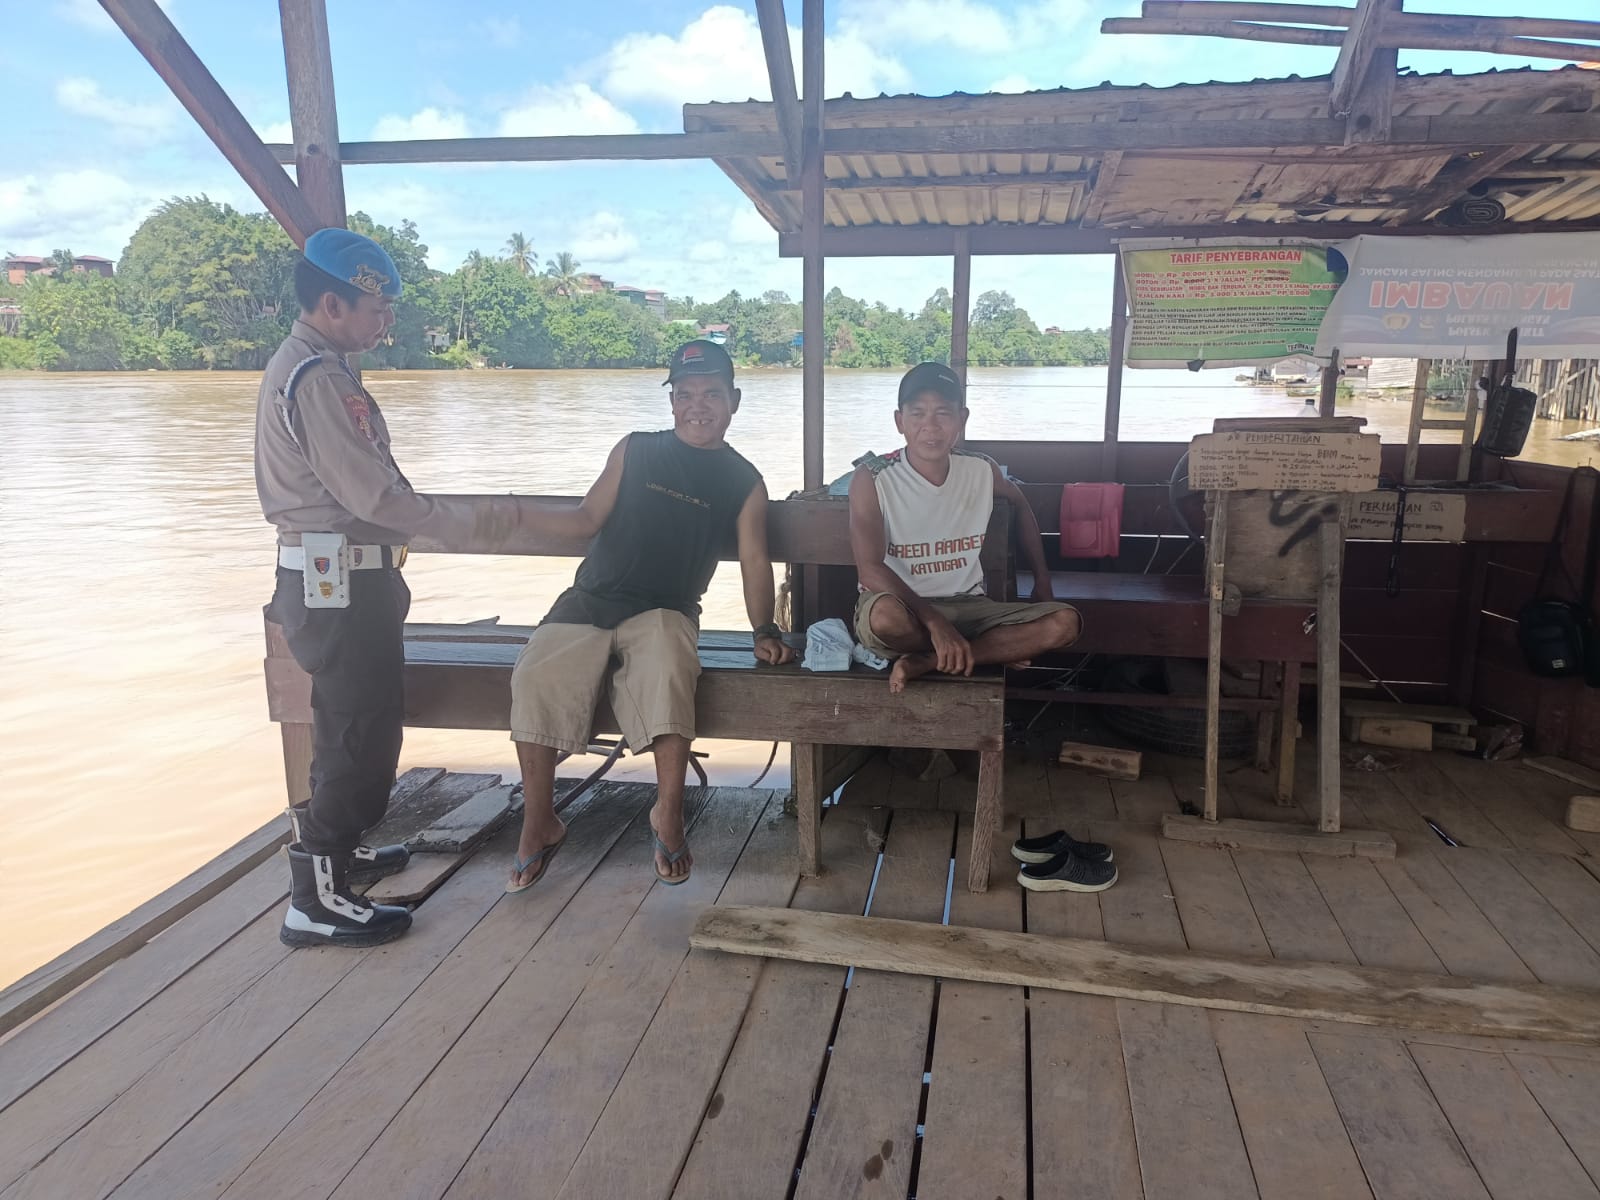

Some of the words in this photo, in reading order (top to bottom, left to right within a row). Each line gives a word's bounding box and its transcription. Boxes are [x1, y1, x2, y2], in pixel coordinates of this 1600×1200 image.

[1170, 253, 1203, 263] TARIF
[1205, 250, 1302, 262] PENYEBRANGAN
[1360, 501, 1422, 513] PERHAAN
[888, 541, 930, 558] GREEN
[910, 557, 968, 576] KATINGAN
